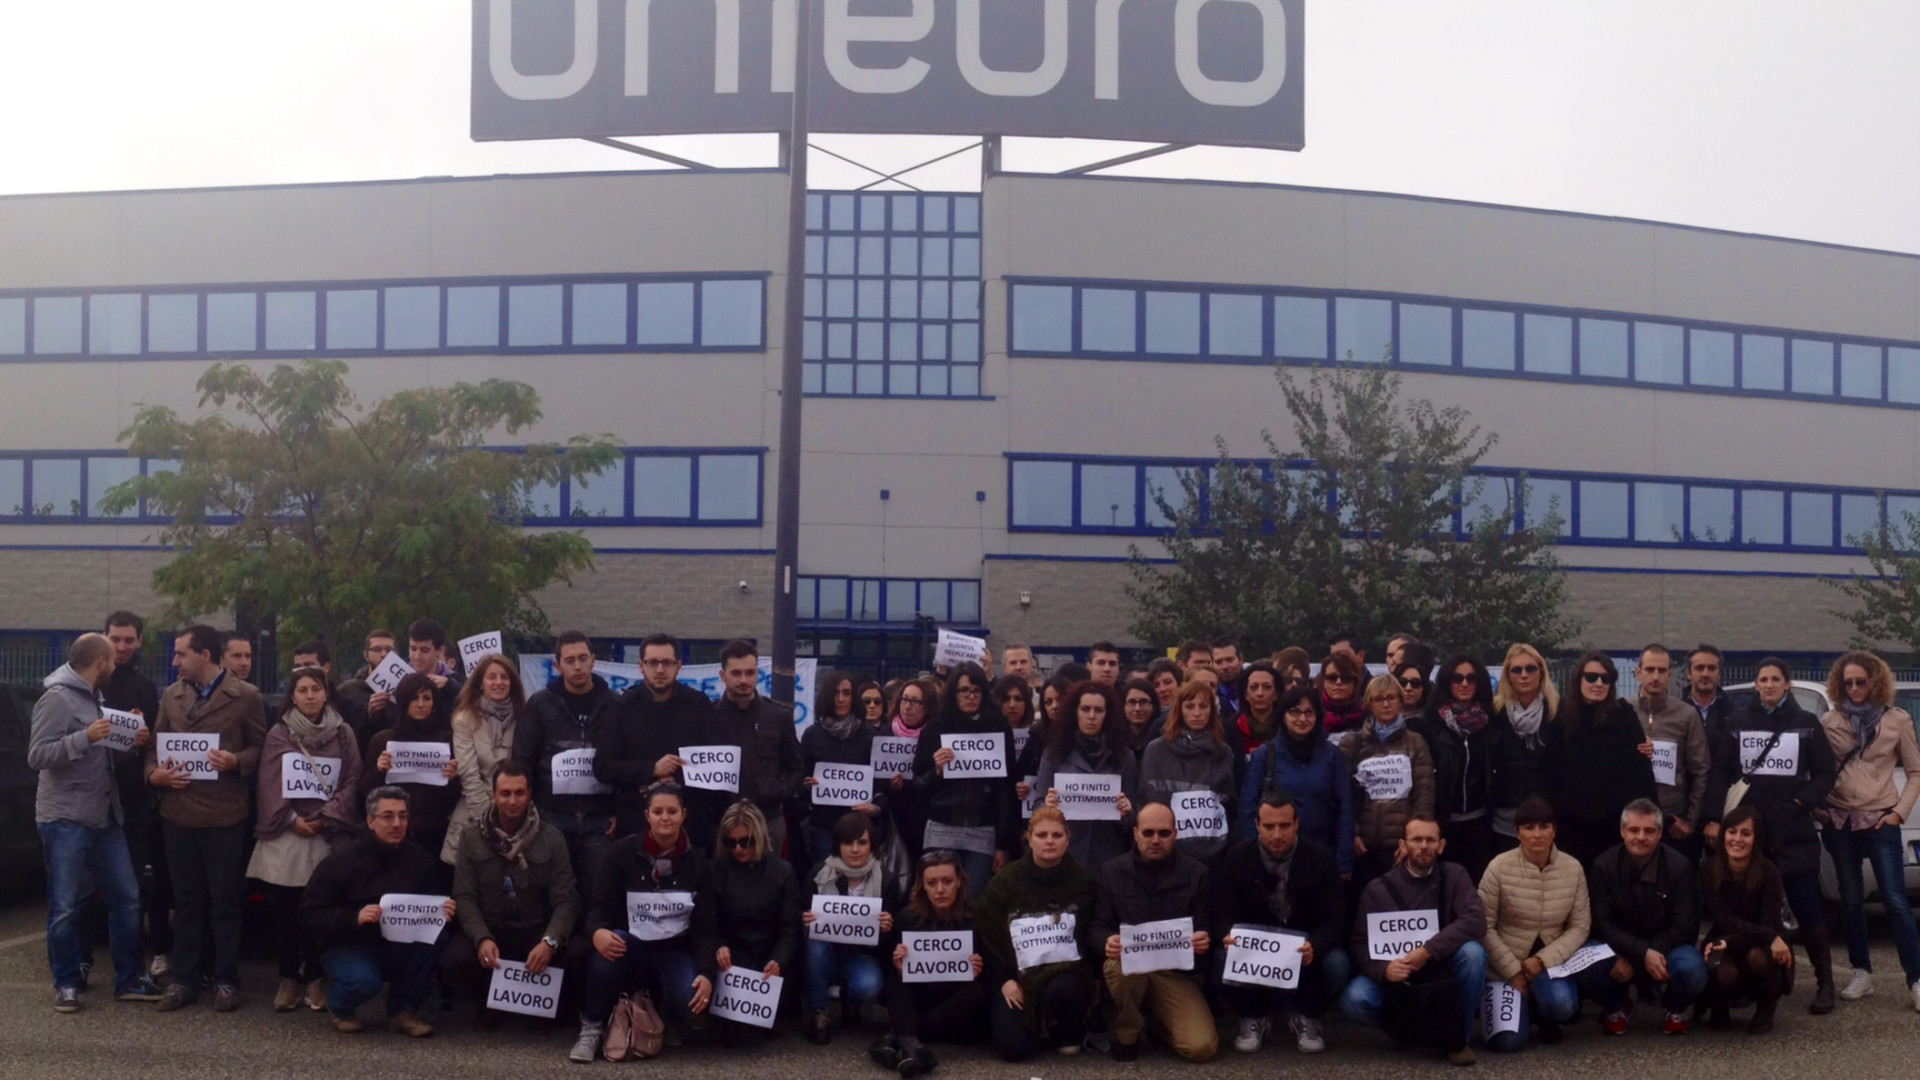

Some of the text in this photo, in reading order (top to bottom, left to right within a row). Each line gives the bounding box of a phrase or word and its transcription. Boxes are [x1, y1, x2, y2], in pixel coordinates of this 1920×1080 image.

[463, 637, 498, 655] CERCO
[944, 649, 965, 657] PEOPLE
[110, 714, 139, 730] CERCO
[166, 739, 209, 752] CERCO
[951, 739, 995, 751] CERCO
[396, 751, 441, 760] HO FINITO
[562, 757, 576, 766] HO
[691, 752, 734, 766] CERCO
[947, 759, 1001, 771] LAVORO
[687, 771, 738, 786] LAVORO
[822, 768, 864, 782] CERCO
[815, 787, 869, 801] LAVORO
[1065, 783, 1111, 791] HO FINITO
[391, 904, 438, 914] HO FINITO
[637, 902, 684, 911] HO FINITO
[822, 901, 870, 917] CERCO
[382, 915, 444, 927] L'OTTIMISMO
[1379, 917, 1428, 933] CERCO
[814, 922, 875, 938] LAVORO
[1020, 922, 1067, 935] HO FINITO
[1133, 929, 1182, 942] HO FINITO
[913, 938, 963, 951] CERCO
[1124, 941, 1191, 954] L'OTTIMISMO
[1234, 935, 1280, 953] CERCO
[907, 960, 969, 974] LAVORO
[1231, 961, 1293, 981] LAVORO
[503, 967, 552, 986] CERCO
[724, 973, 771, 994] CERCO
[493, 988, 554, 1010] LAVORO
[715, 994, 772, 1019] LAVORO
